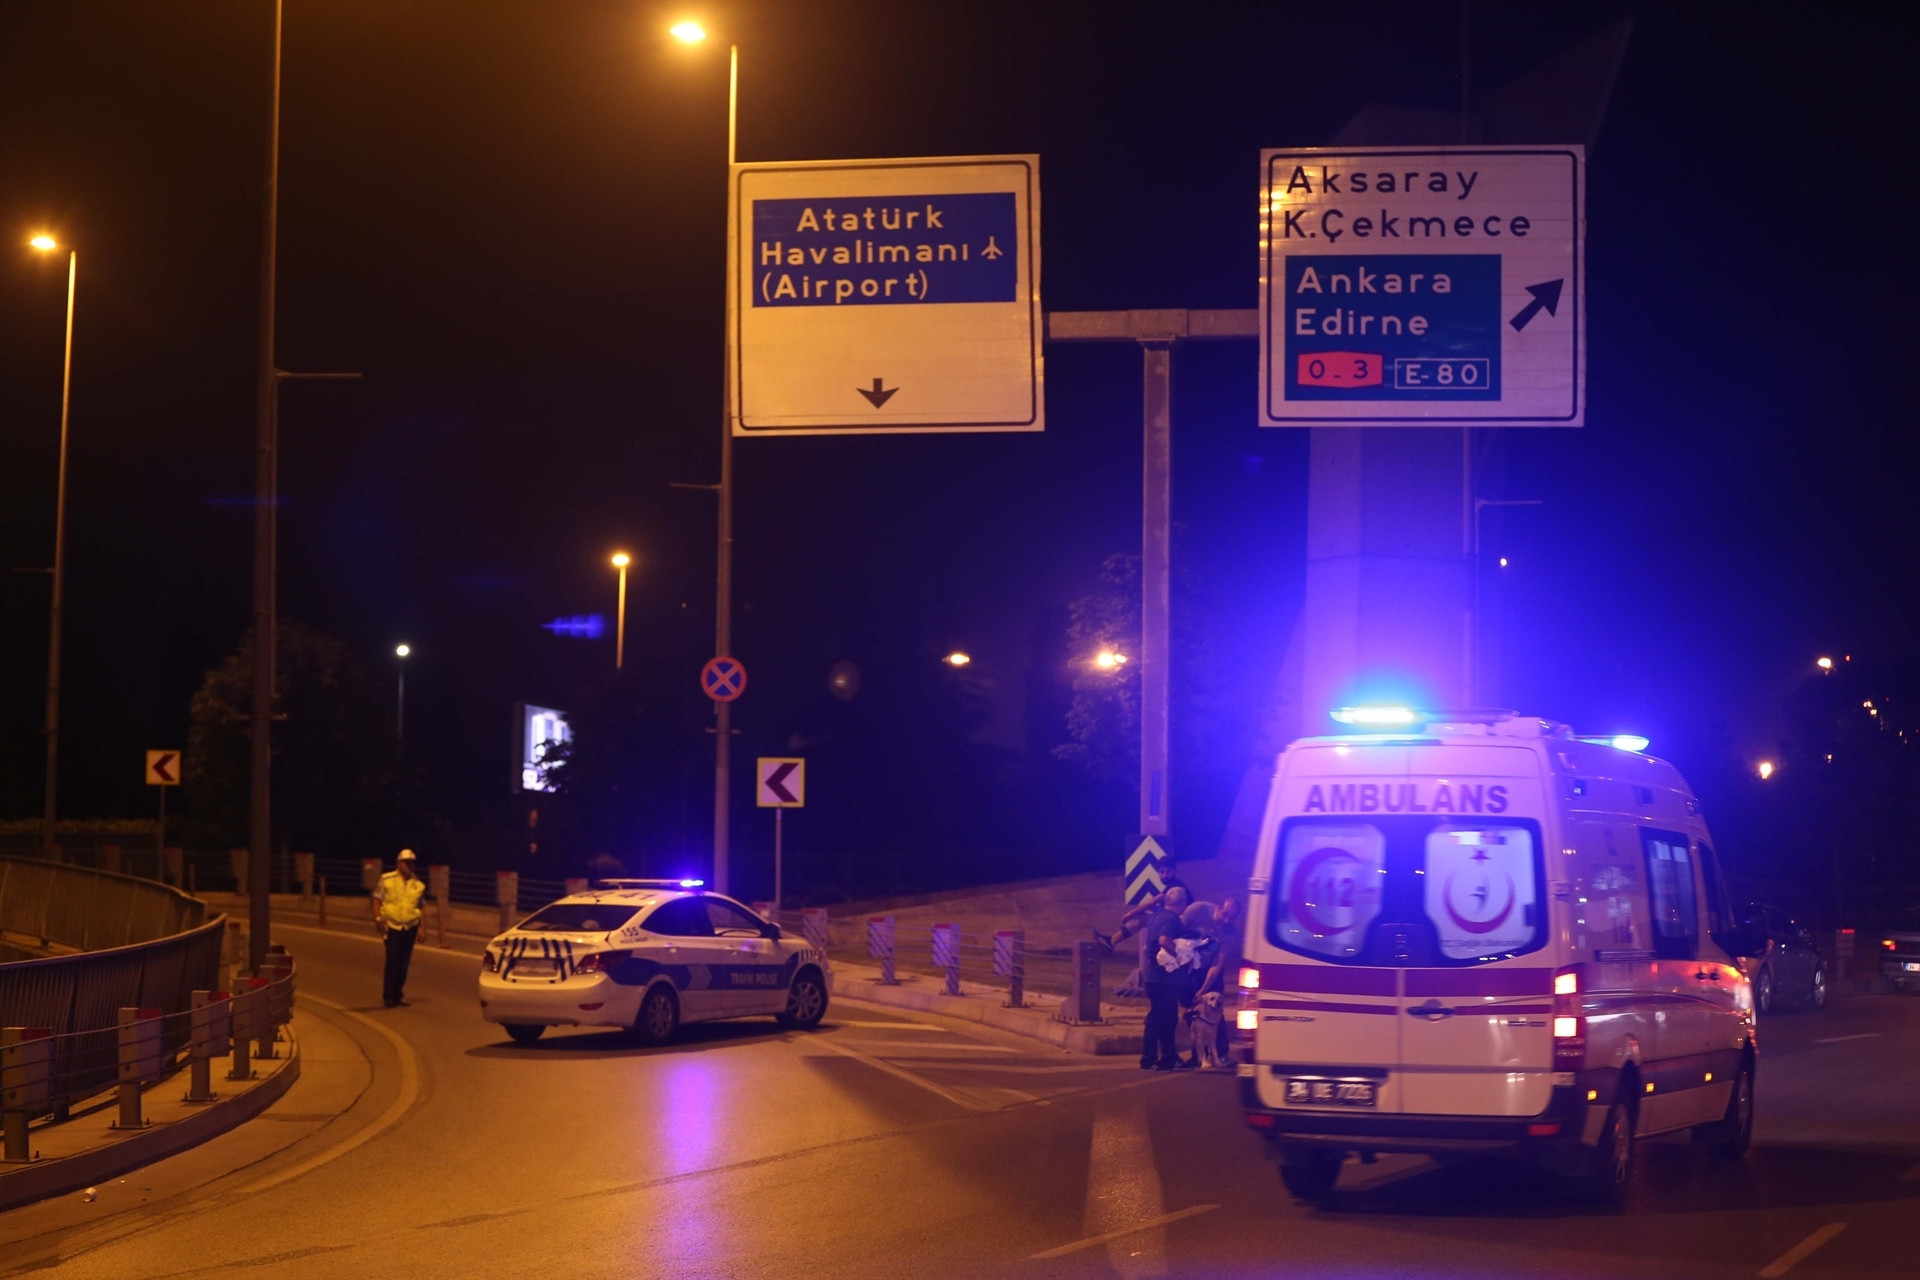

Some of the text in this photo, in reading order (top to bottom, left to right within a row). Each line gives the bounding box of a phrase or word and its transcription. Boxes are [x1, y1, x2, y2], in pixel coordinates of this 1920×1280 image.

[1286, 165, 1478, 200] Aksaray
[797, 204, 943, 232] Atatürk
[1284, 209, 1531, 243] K.Çekmece
[761, 239, 969, 266] Havalimanı
[761, 270, 928, 303] (Airport)
[1296, 266, 1452, 294] Ankara
[1295, 308, 1429, 335] Edirne
[1405, 363, 1479, 385] E-80
[1302, 783, 1510, 813] AMBULANS
[1306, 877, 1355, 908] 112
